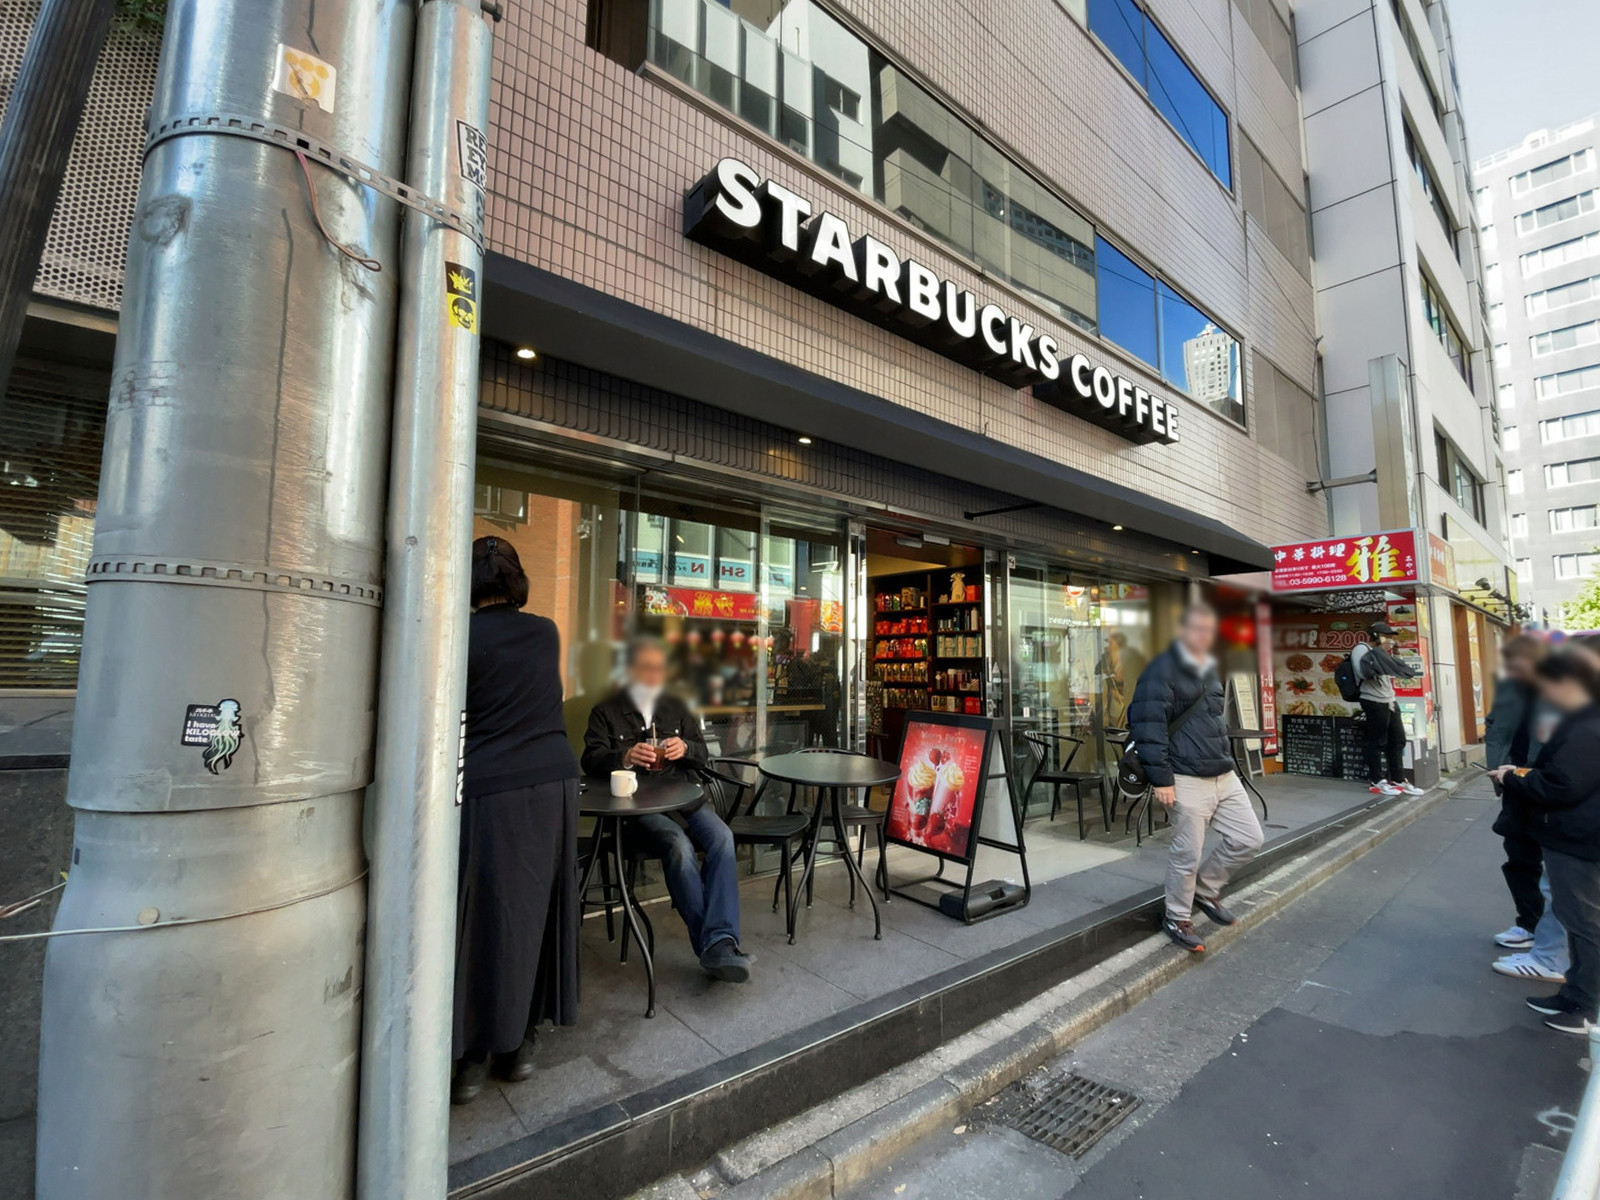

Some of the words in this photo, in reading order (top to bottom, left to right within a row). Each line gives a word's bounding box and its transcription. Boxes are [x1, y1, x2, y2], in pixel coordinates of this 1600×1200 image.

[715, 157, 1059, 380] STARBUCKS
[1071, 353, 1180, 444] COFFEE
[1274, 542, 1346, 563] 中華料理
[1345, 535, 1405, 582] 雅
